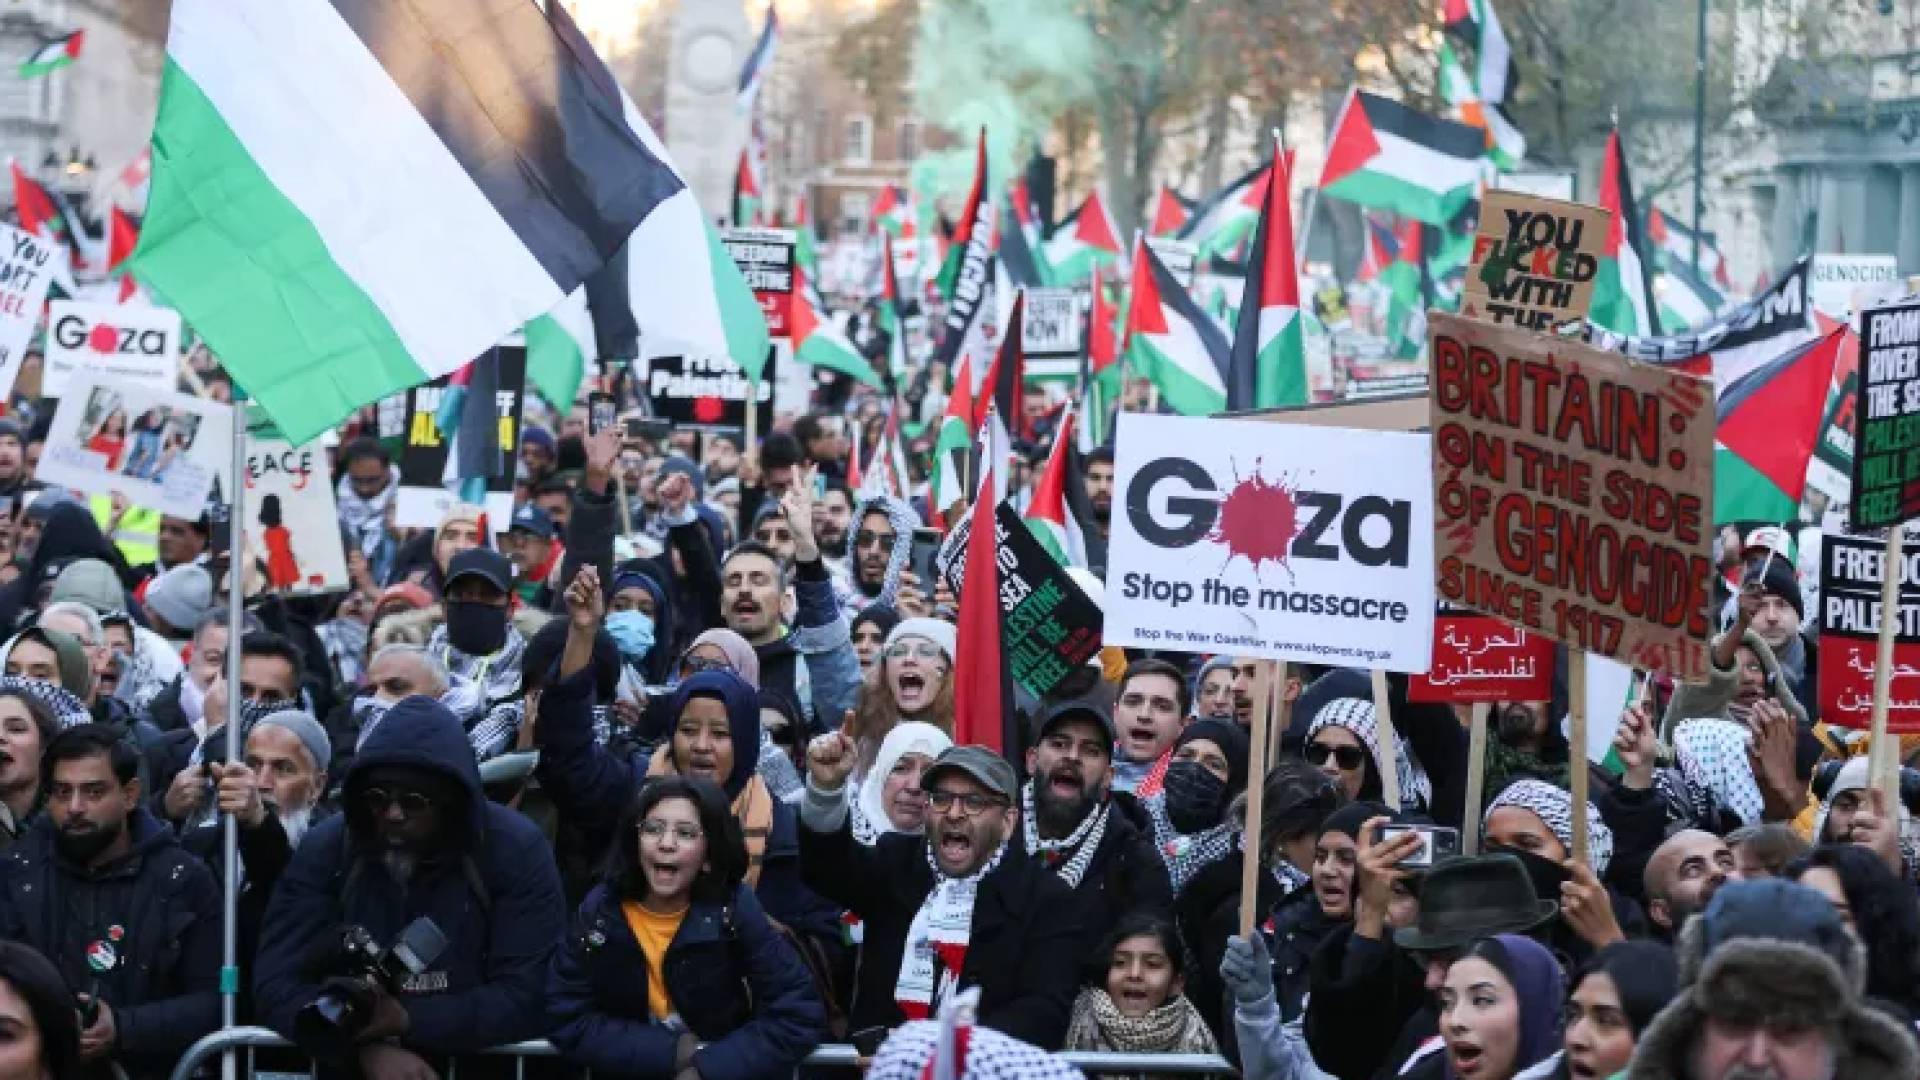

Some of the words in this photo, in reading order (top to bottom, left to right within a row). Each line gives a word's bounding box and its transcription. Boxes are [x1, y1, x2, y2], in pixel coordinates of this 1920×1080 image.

[1504, 208, 1584, 249] YOU
[12, 232, 50, 267] YOU
[1471, 233, 1598, 282] FUCKED
[1487, 274, 1574, 307] WITH
[1815, 263, 1897, 283] GENOCIDE
[55, 315, 166, 355] Gza
[1868, 346, 1918, 383] RIVER
[1435, 335, 1687, 470] BRITAIN:
[1867, 383, 1900, 419] THE
[247, 451, 313, 479] EACE
[1437, 422, 1506, 483] ON
[1512, 441, 1593, 508] THE
[1602, 468, 1703, 545] SIDE
[1126, 456, 1412, 569] Gza
[1438, 478, 1492, 527] OF
[1494, 492, 1711, 638] GENOCIDE
[998, 572, 1032, 611] SEA
[1005, 576, 1067, 647] LESTINE
[1122, 571, 1194, 608] Stop
[1202, 578, 1250, 607] the
[1257, 588, 1409, 623] massacre
[1437, 554, 1541, 628] SINCE
[1552, 598, 1626, 656] 1917
[1134, 627, 1161, 641] Stop
[1165, 629, 1184, 642] the
[1187, 631, 1211, 643] War
[1214, 633, 1267, 649] Coalition
[1442, 624, 1526, 654] الحرية
[1019, 652, 1072, 700] FREE
[1429, 655, 1536, 685] لفلسطين
